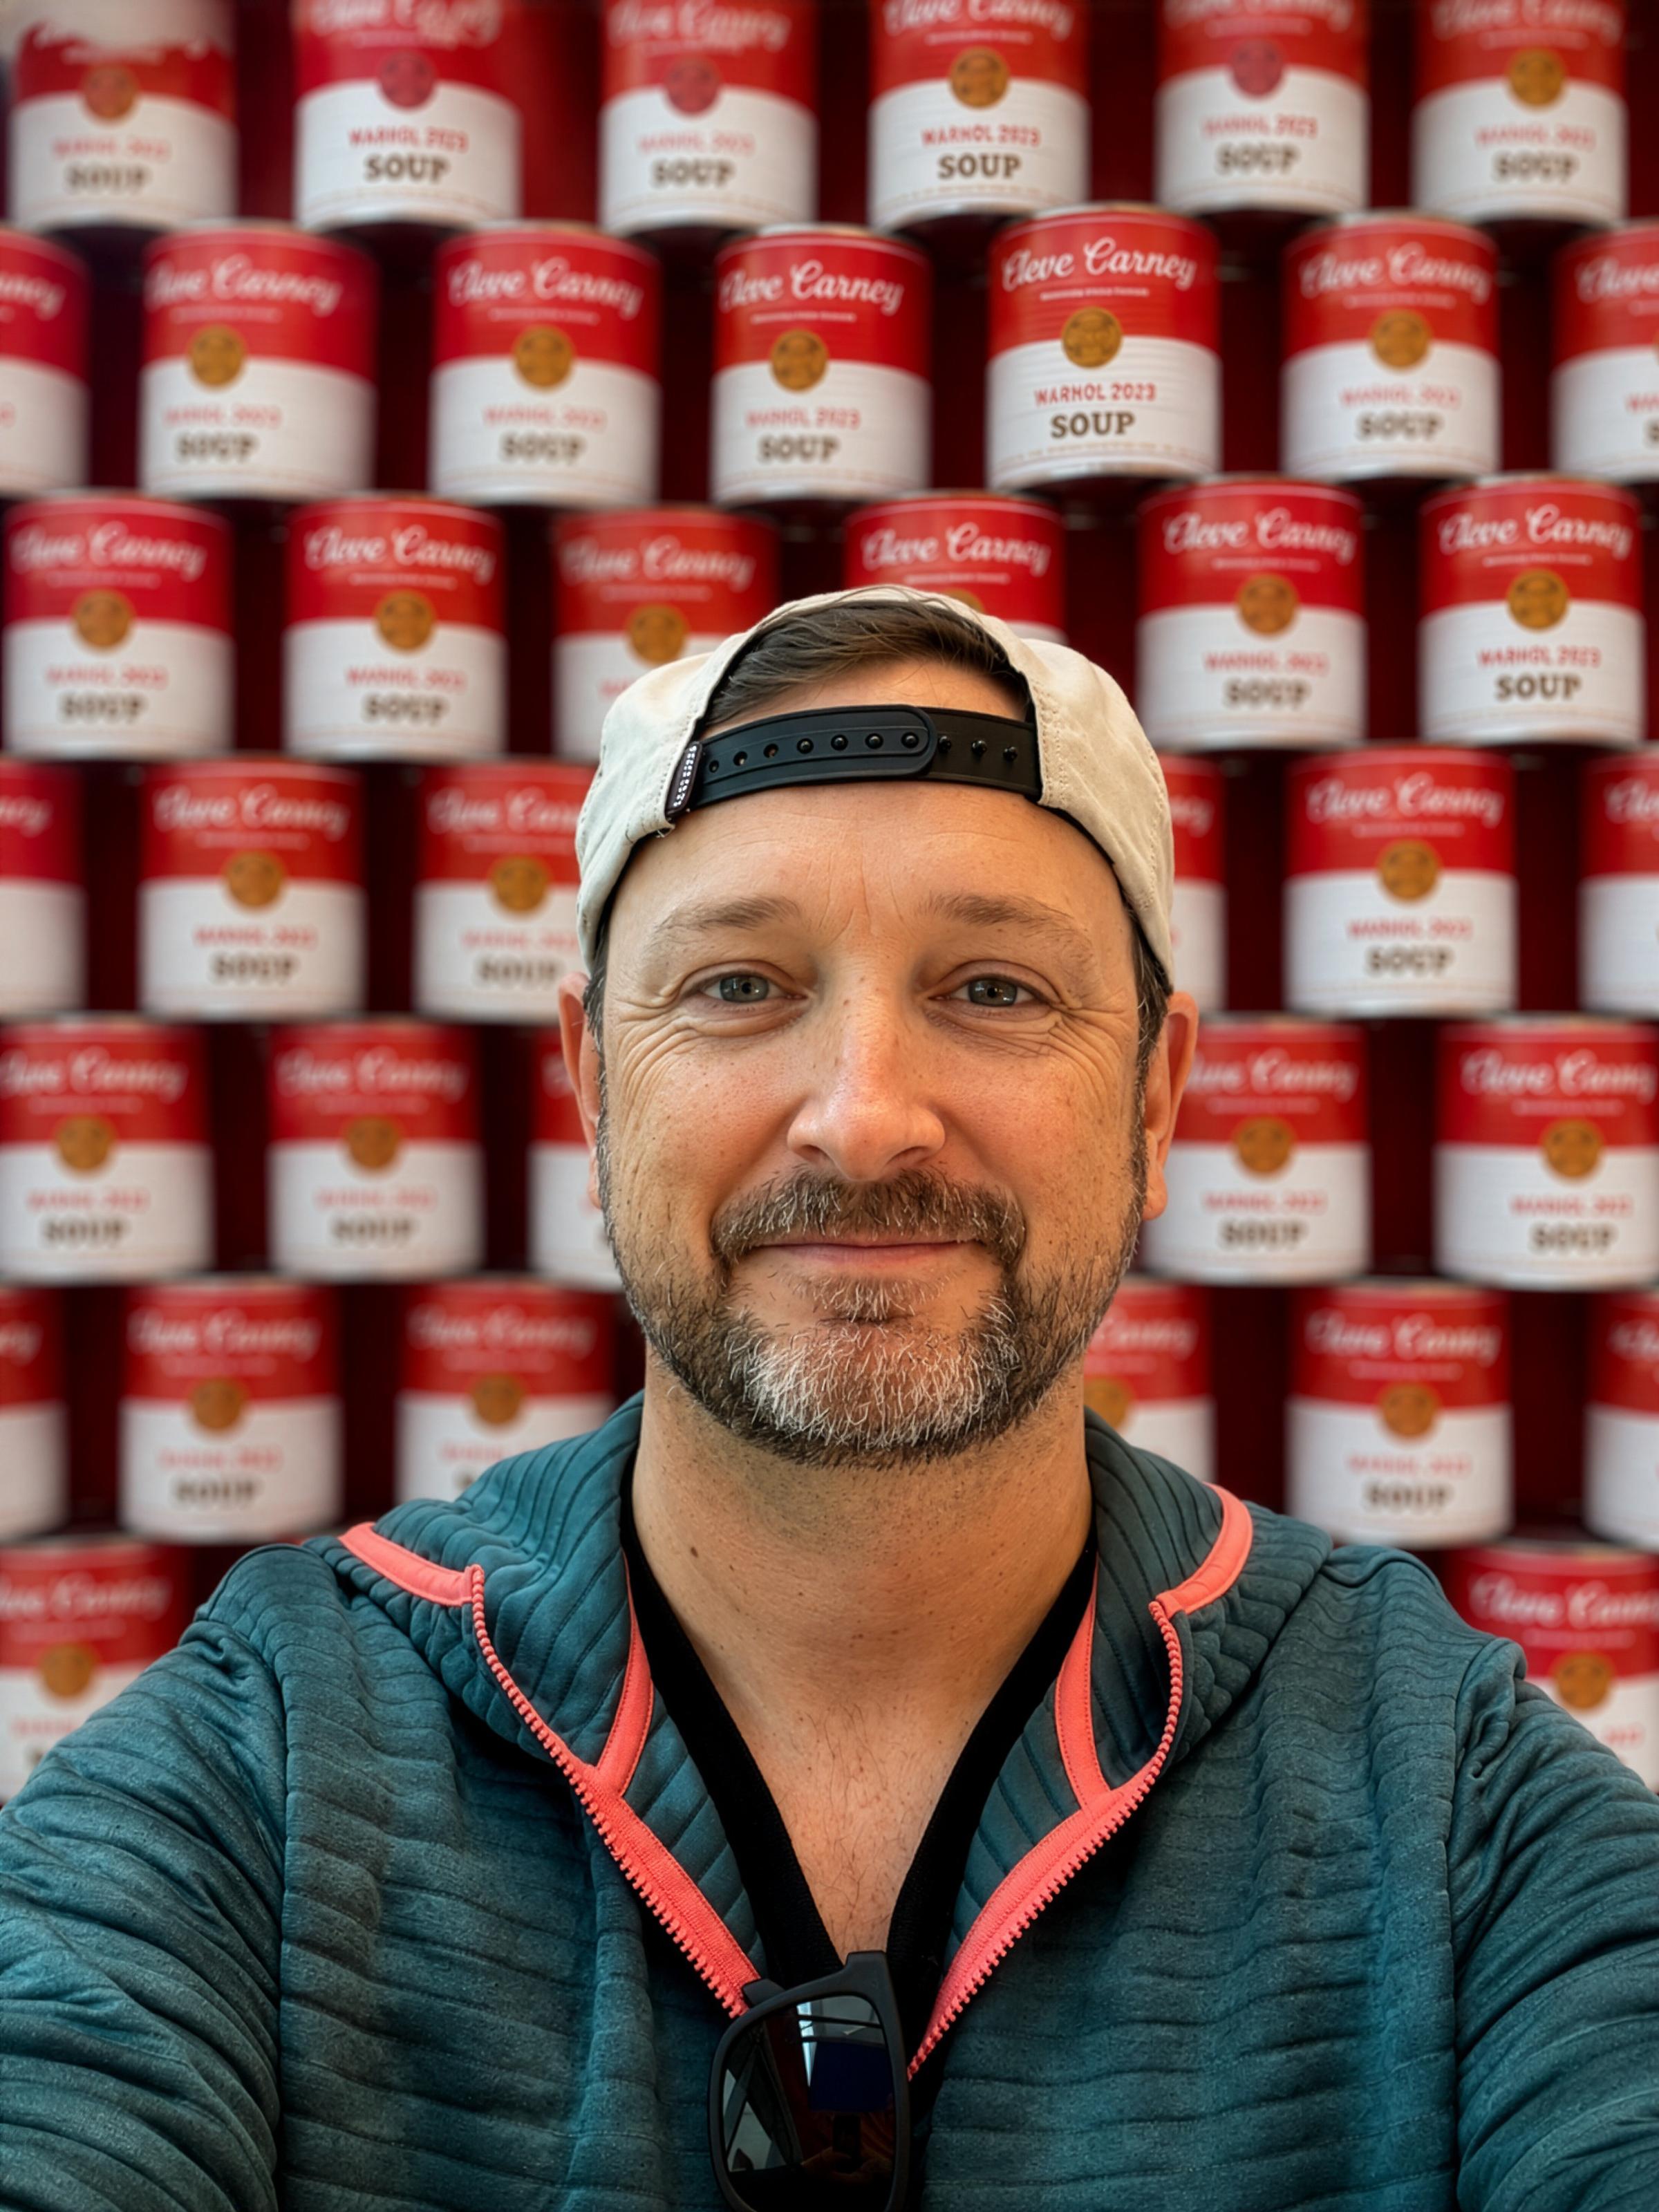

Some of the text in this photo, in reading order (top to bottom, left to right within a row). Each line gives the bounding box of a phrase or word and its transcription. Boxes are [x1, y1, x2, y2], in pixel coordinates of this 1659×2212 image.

[365, 153, 449, 182] SOUP
[937, 153, 1022, 180] SOUP
[1002, 236, 1197, 292] Cleve Carney
[1034, 382, 1157, 405] WARHOL 2023
[1050, 411, 1135, 439] SOUP
[759, 434, 841, 463] SOUP
[1494, 674, 1582, 701] SOUP
